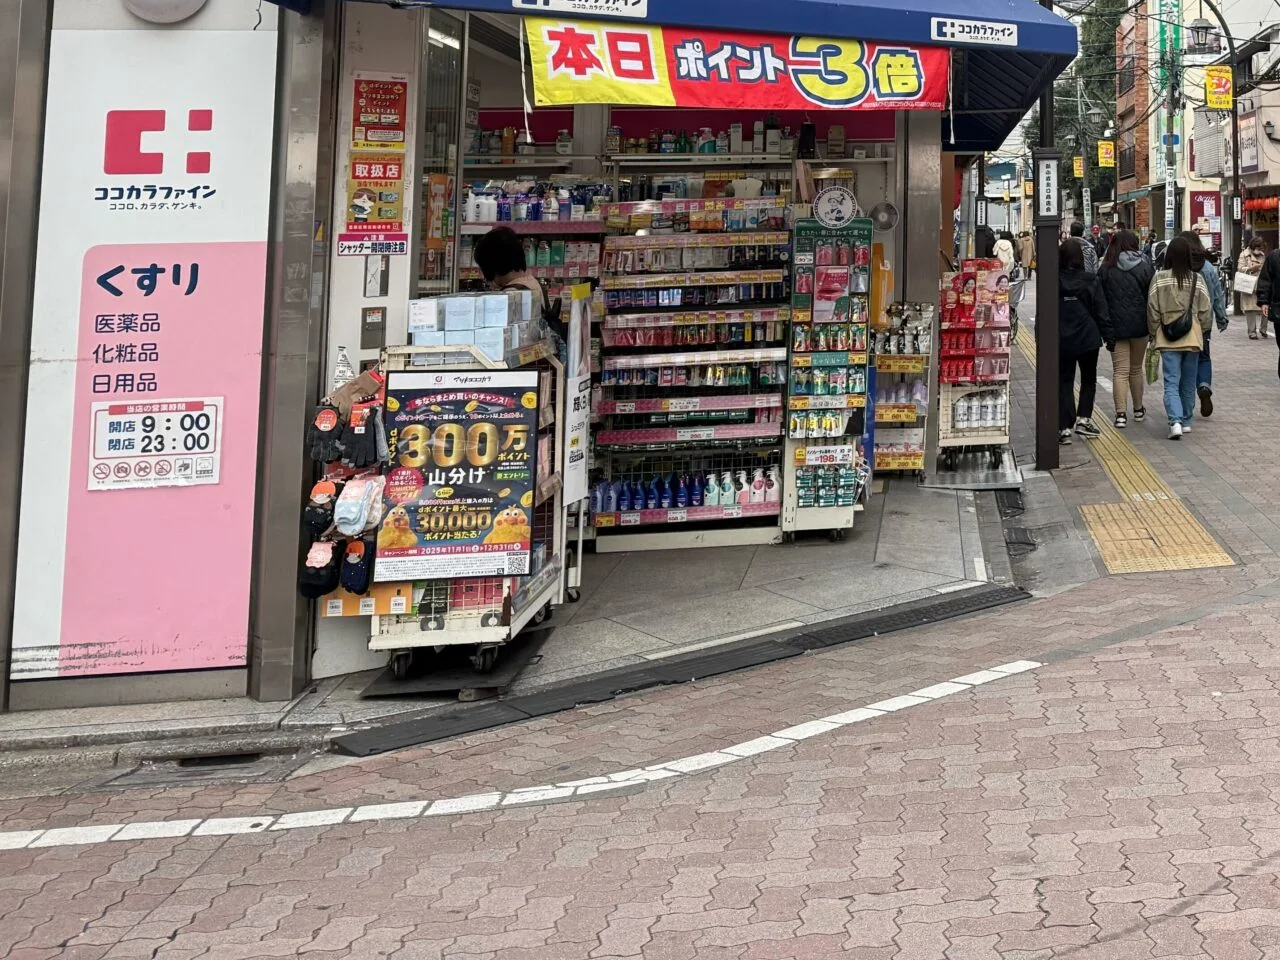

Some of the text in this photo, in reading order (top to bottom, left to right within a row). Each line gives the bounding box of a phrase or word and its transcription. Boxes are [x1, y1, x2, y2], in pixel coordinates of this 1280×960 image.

[958, 24, 1013, 37] ココカラファイン
[548, 26, 657, 80] 本日
[355, 164, 399, 177] 取扱店
[95, 185, 216, 200] ココカラファイン
[109, 202, 203, 212] ココロ、カラダ、ゲンキ。
[339, 242, 405, 254] シャッター開閉時注意
[96, 262, 200, 297] くすり
[94, 313, 161, 335] 医薬品
[92, 342, 160, 364] 化粧品
[92, 371, 158, 394] 日用品
[415, 393, 509, 406] 今ならまとめ買いのチャンス!
[127, 403, 186, 413] 当店の営業時間
[108, 420, 136, 434] 開店
[108, 438, 136, 451] 閉店
[400, 422, 529, 468] 300万
[497, 451, 531, 461] ポイント
[428, 467, 486, 485] 山分け
[416, 511, 492, 532] 30,000
[424, 530, 482, 541] ポイント当たる!
